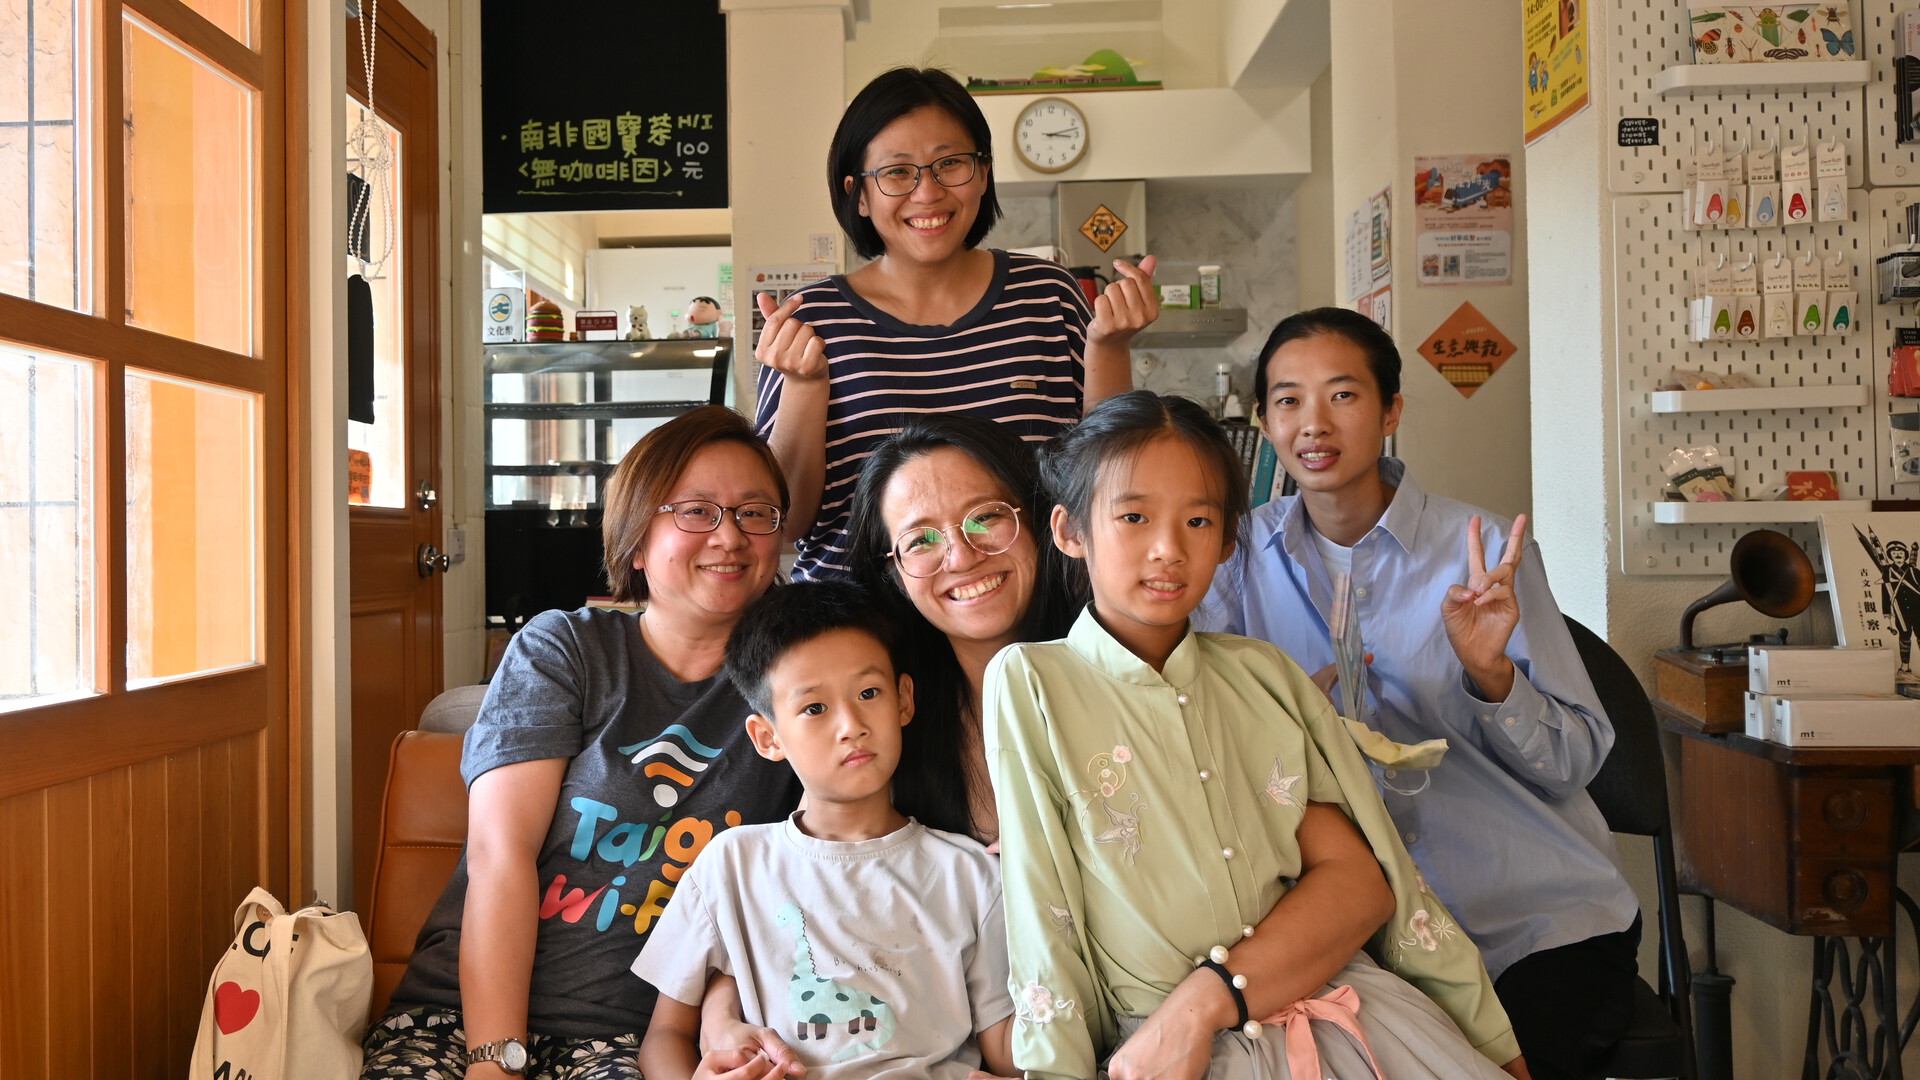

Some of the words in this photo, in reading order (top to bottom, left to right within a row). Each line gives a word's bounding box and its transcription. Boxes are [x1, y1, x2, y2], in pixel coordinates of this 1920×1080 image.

[1035, 108, 1042, 117] 11
[1048, 105, 1055, 114] 12
[1025, 118, 1033, 127] 10
[1071, 118, 1076, 126] 2
[520, 111, 673, 159] 南非國寶茶
[1022, 131, 1028, 139] 9
[677, 141, 710, 157] 100
[1026, 144, 1032, 152] 8
[1071, 143, 1076, 151] 4
[1036, 153, 1040, 161] 7
[1048, 156, 1054, 164] 6
[1062, 153, 1067, 161] 5
[682, 161, 704, 180] 元
[1800, 730, 1815, 738] mt
[570, 796, 742, 882] Taig
[539, 873, 677, 935] wi-f
